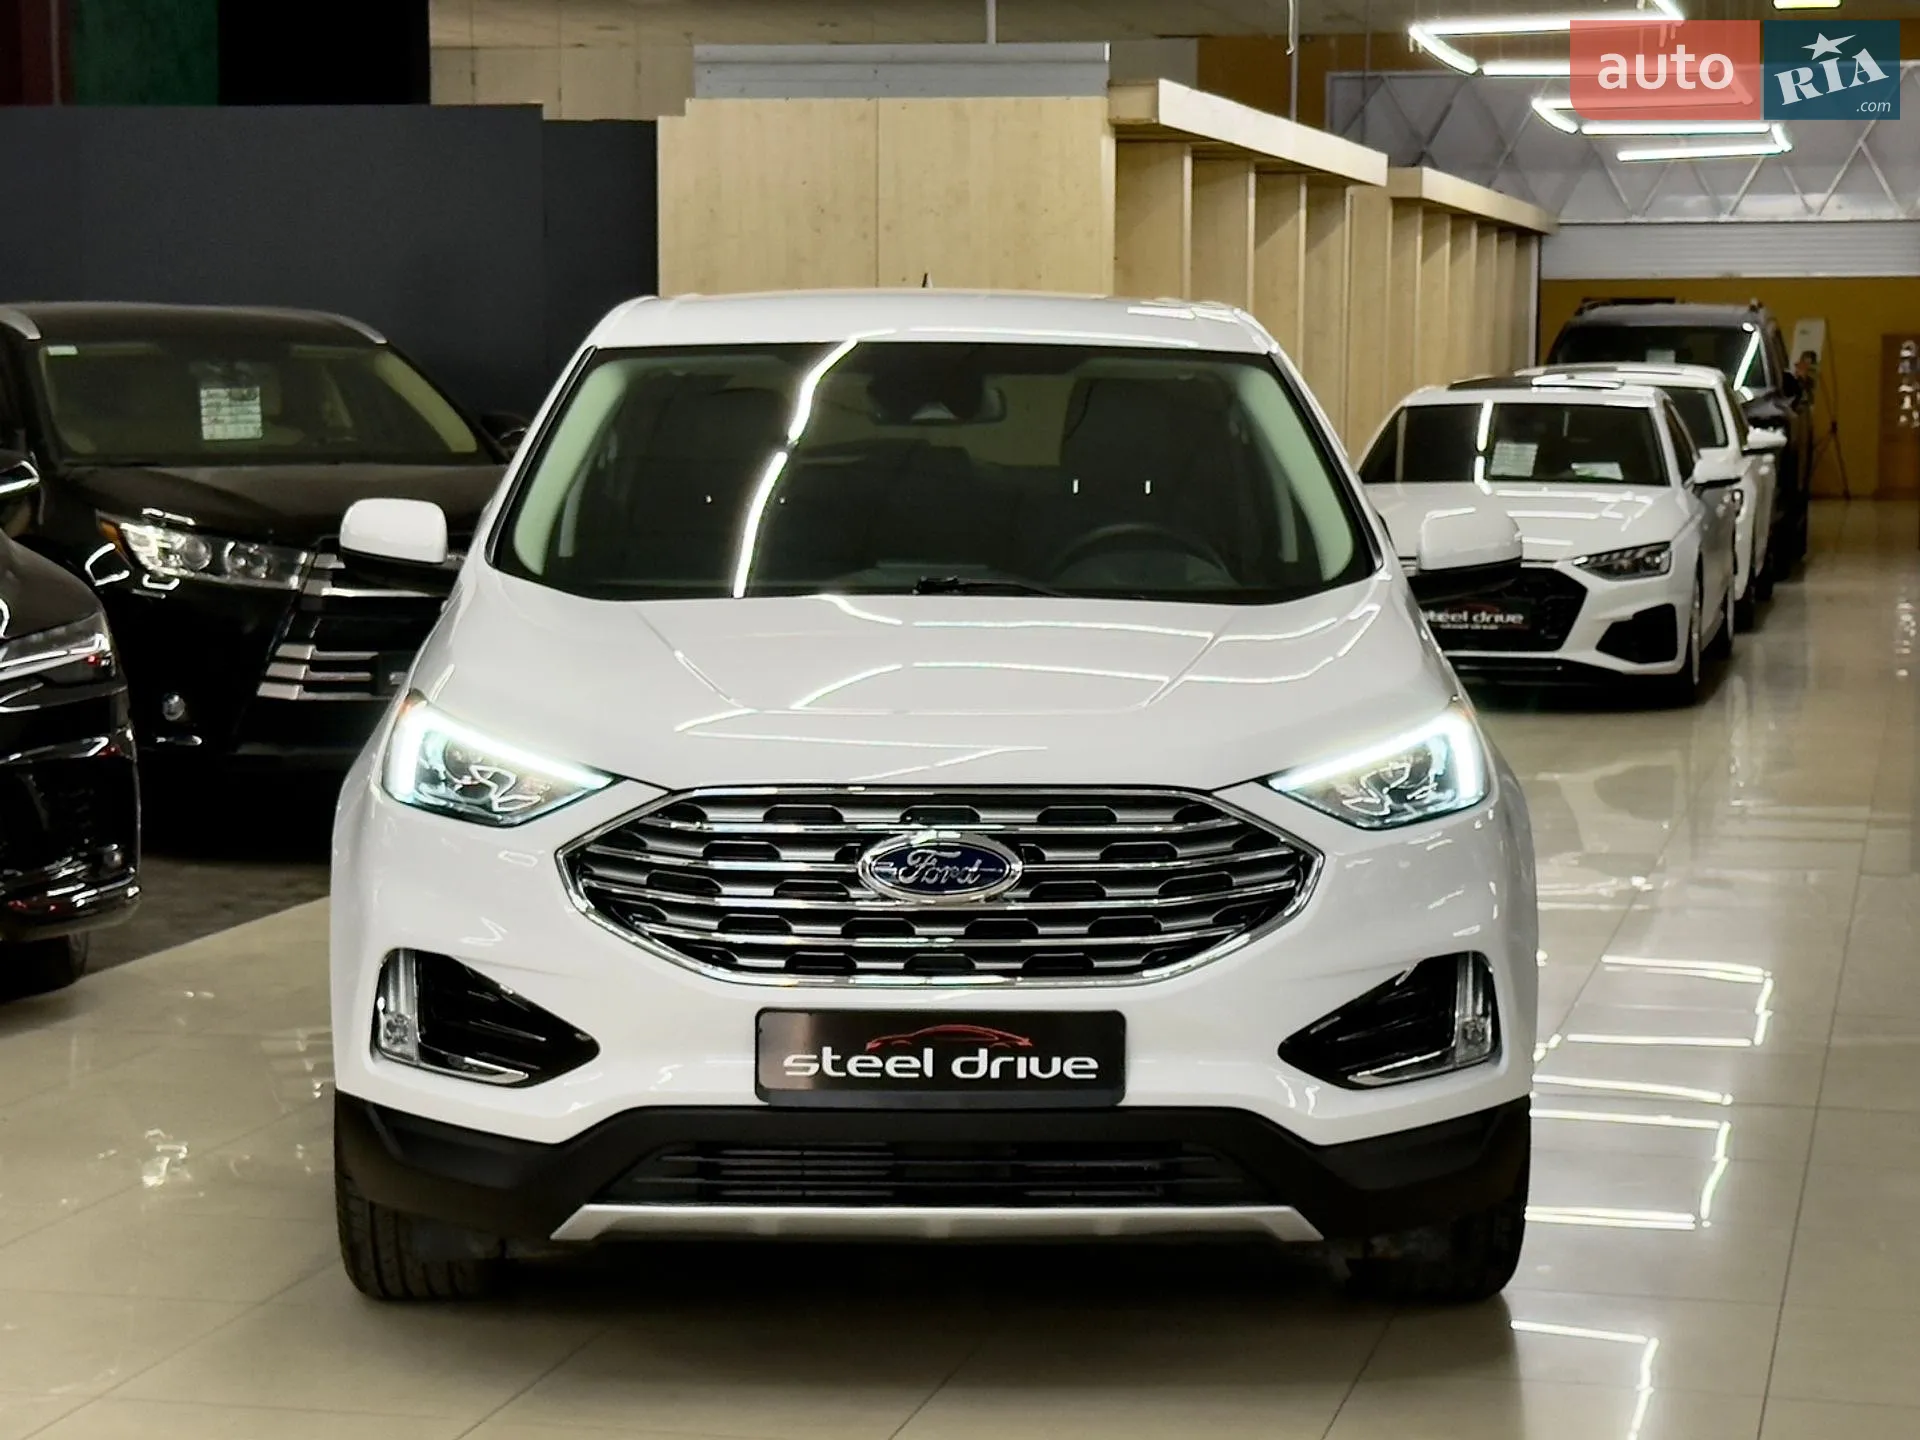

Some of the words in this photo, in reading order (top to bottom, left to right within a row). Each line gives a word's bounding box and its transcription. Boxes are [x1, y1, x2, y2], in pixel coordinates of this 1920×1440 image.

[1473, 610, 1524, 624] drive
[898, 848, 983, 885] Ford
[783, 1046, 933, 1078] steel
[951, 1047, 1099, 1080] drive
